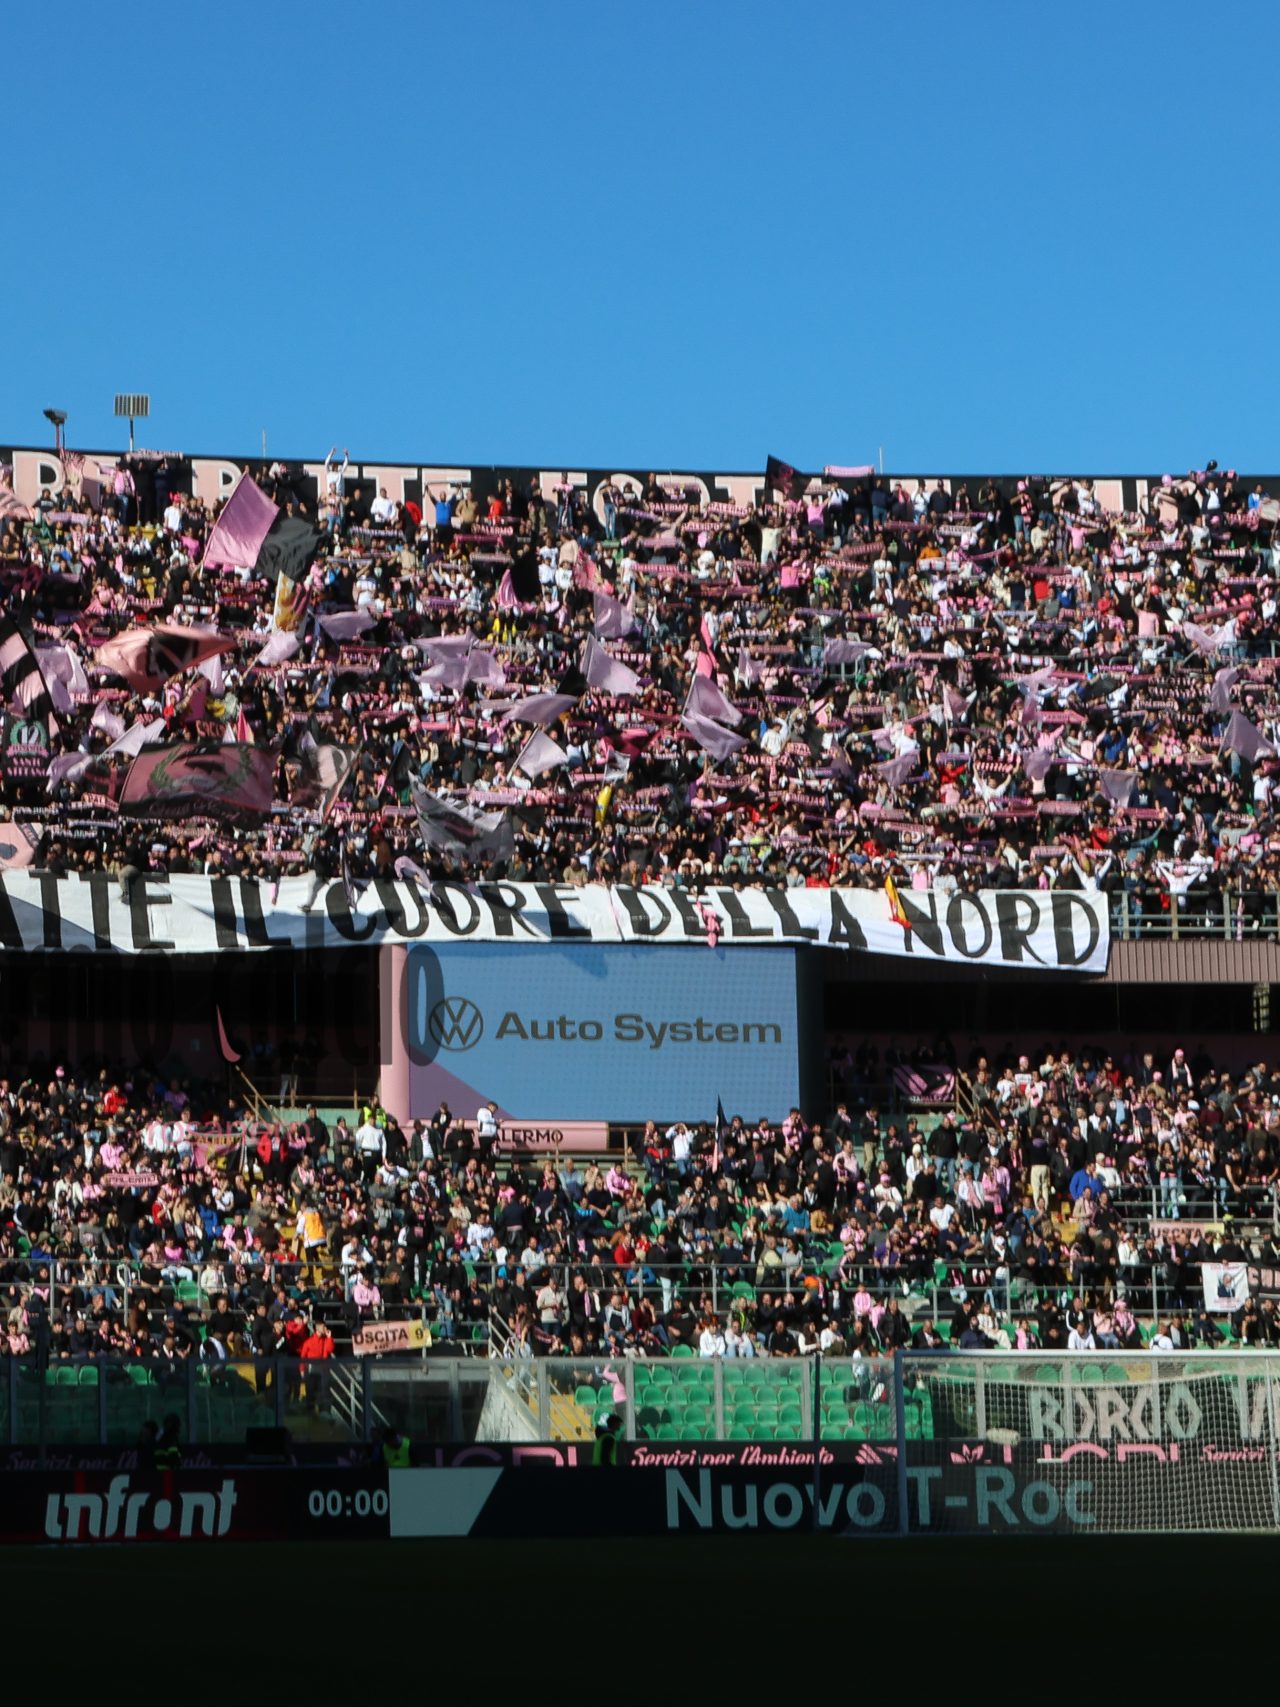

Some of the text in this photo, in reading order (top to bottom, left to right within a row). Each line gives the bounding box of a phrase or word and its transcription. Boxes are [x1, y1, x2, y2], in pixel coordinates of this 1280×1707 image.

[210, 879, 291, 948] IL
[325, 878, 591, 941] CUORE
[618, 885, 868, 948] DELLA
[892, 891, 1100, 967] NORD
[495, 1012, 603, 1040] Auto
[614, 1013, 782, 1049] System
[353, 1326, 424, 1345] USCITA 9
[631, 1446, 696, 1467] Servizi
[702, 1452, 736, 1467] per
[308, 1489, 389, 1518] 00:00
[665, 1465, 1097, 1529] Nuovo T-Roc
